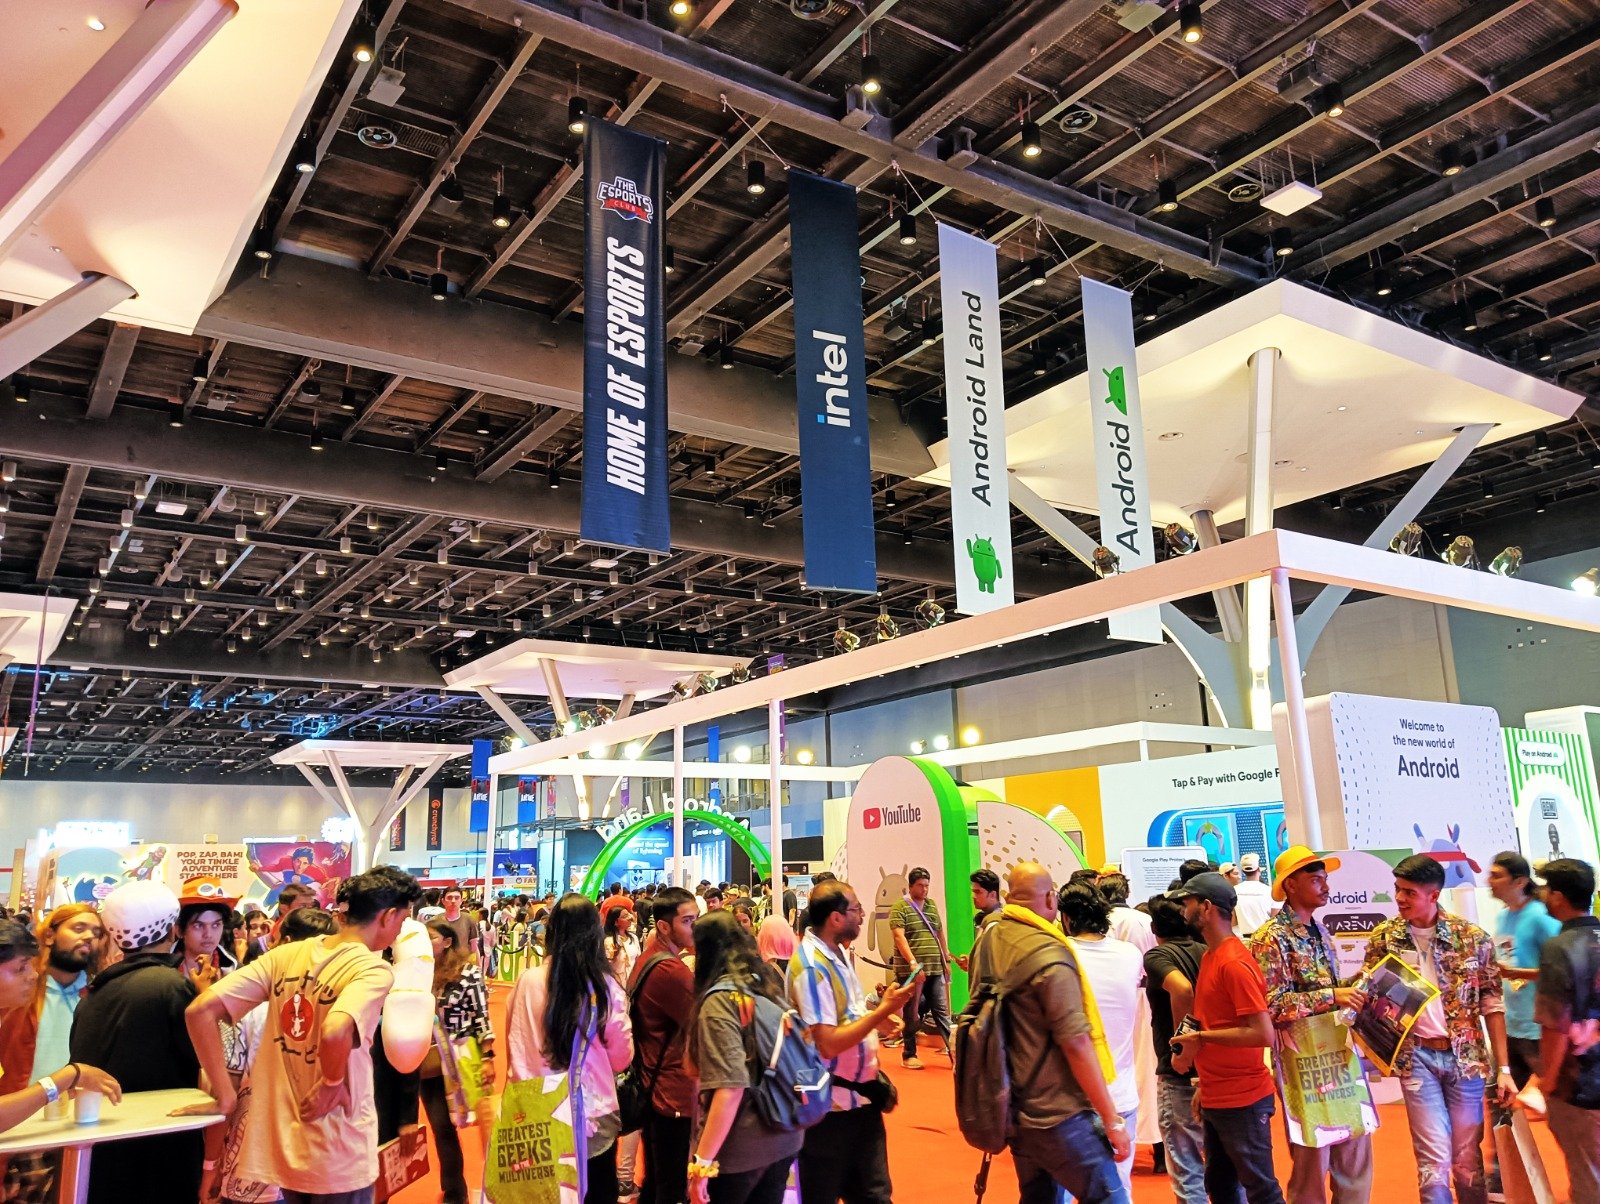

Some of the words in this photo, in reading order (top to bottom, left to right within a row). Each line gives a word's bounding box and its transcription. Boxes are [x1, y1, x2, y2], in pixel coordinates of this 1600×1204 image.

[617, 180, 634, 193] THE
[599, 184, 652, 213] ESPORTS
[614, 201, 636, 212] CLUB
[606, 236, 646, 368] ESPORTS
[962, 291, 986, 370] Land
[606, 364, 646, 410] OF
[812, 329, 851, 428] intel
[606, 408, 646, 496] HOME
[967, 375, 992, 508] Android
[1106, 421, 1141, 556] Android
[1399, 718, 1435, 732] Welcome
[1436, 723, 1445, 733] to
[1393, 734, 1406, 746] the
[1408, 738, 1424, 747] new
[1425, 738, 1446, 749] world
[1447, 738, 1455, 749] of
[1398, 754, 1460, 779] Android
[1172, 778, 1188, 789] Tap
[1190, 776, 1196, 787] &
[1197, 775, 1214, 787] Pay
[1215, 773, 1236, 784] with
[1238, 769, 1273, 782] Google
[882, 803, 921, 826] YouTube
[177, 851, 197, 859] POP,
[199, 851, 219, 859] ZAP,
[1328, 890, 1368, 905] ndroid
[1335, 920, 1375, 931] ARENA
[1296, 1049, 1347, 1071] GREATEST
[1299, 1063, 1351, 1091] GEEKS
[1304, 1086, 1357, 1105] MULTIVERSE
[498, 1121, 551, 1143] GREATEST
[498, 1138, 553, 1168] GEEKS
[499, 1165, 556, 1184] MULTIVERSE
